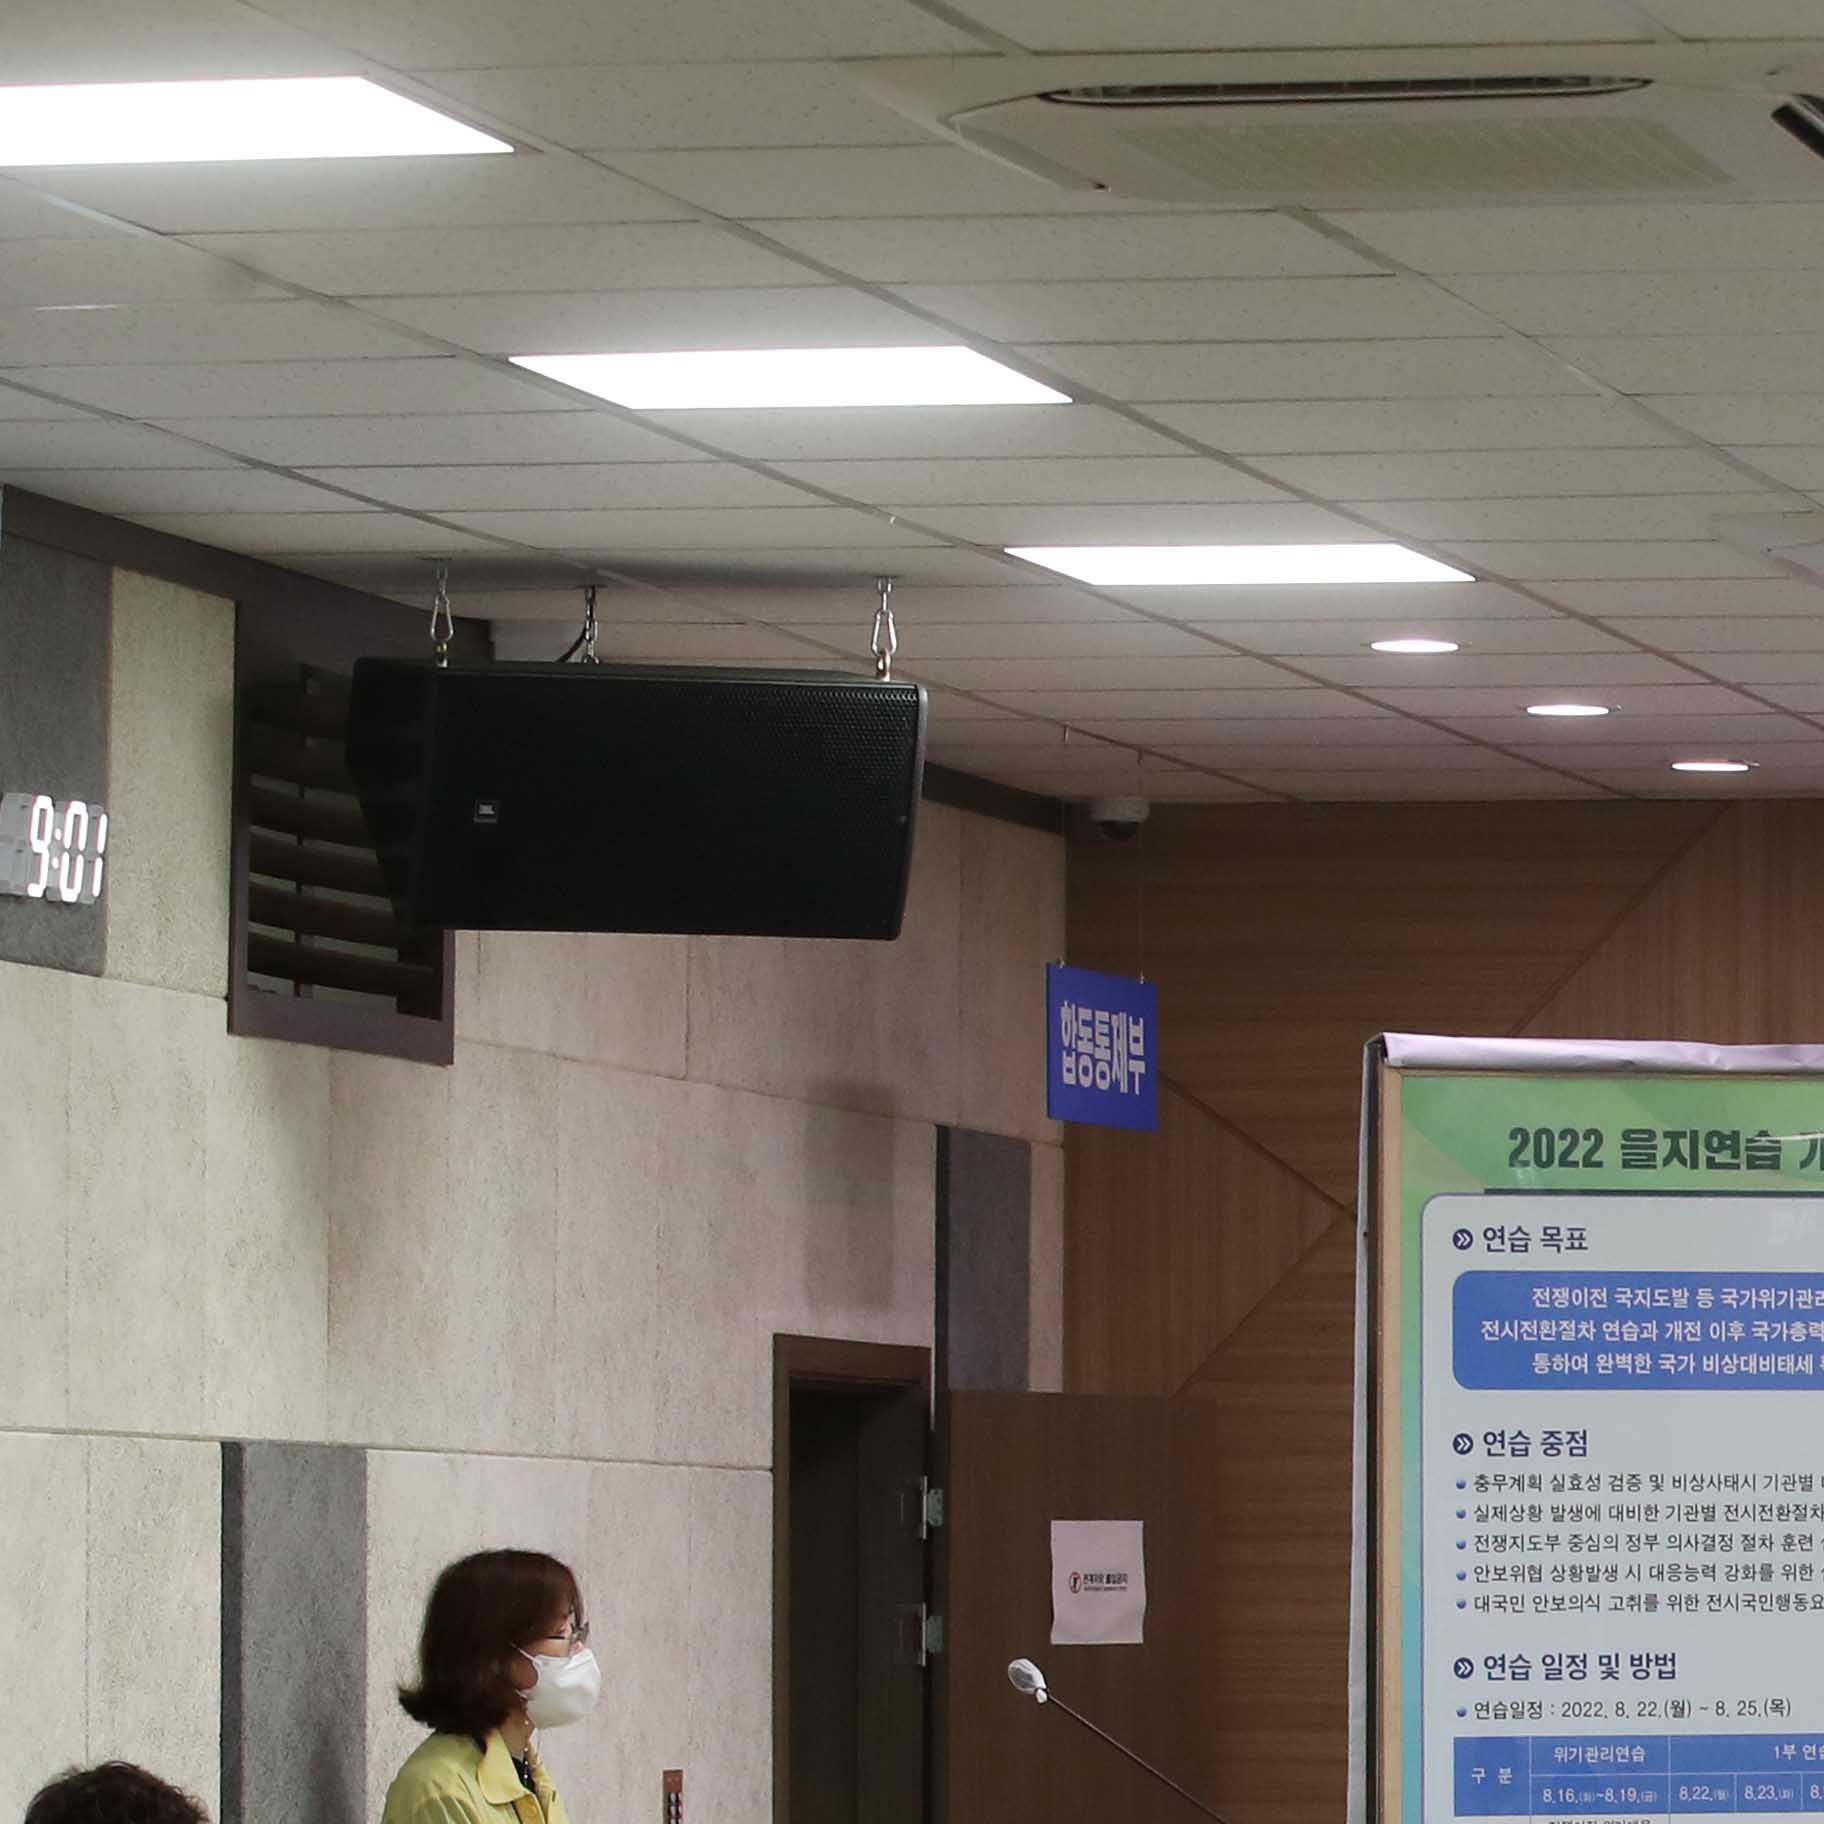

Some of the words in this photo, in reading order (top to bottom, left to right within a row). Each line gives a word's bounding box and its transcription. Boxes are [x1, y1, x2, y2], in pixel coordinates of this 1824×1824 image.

[27, 795, 108, 902] 9:01
[1060, 1000, 1146, 1096] 합동통제부
[1508, 1127, 1604, 1169] 2022
[1619, 1127, 1783, 1171] 을지연습
[1483, 1225, 1532, 1253] 연습
[1540, 1225, 1588, 1253] 목표
[1531, 1287, 1608, 1311] 전쟁이전
[1614, 1287, 1689, 1311] 국지도발
[1695, 1287, 1715, 1311] 등
[1480, 1320, 1596, 1343] 전시전환절차
[1602, 1320, 1659, 1343] 연습과
[1664, 1320, 1702, 1343] 개전
[1709, 1320, 1746, 1343] 이후
[1531, 1353, 1589, 1376] 통하여
[1595, 1353, 1652, 1376] 완벽한
[1658, 1353, 1696, 1376] 국가
[1702, 1353, 1814, 1376] 비상대비태세
[1483, 1430, 1532, 1457] 연습
[1540, 1430, 1588, 1457] 중점
[1473, 1473, 1543, 1493] 충무계획
[1550, 1473, 1601, 1493] 실효성
[1608, 1473, 1642, 1493] 검증
[1648, 1473, 1665, 1493] 및
[1672, 1473, 1757, 1493] 비상사태시
[1763, 1473, 1814, 1493] 기관별
[1473, 1503, 1543, 1523] 실제상황
[1550, 1503, 1601, 1523] 발생에
[1608, 1503, 1659, 1523] 대비한
[1665, 1503, 1717, 1523] 기관별
[1473, 1534, 1561, 1553] 전쟁지도부
[1568, 1534, 1619, 1553] 중심의
[1625, 1534, 1661, 1553] 정부
[1666, 1534, 1734, 1553] 의사결정
[1740, 1534, 1774, 1553] 절차
[1780, 1534, 1814, 1553] 훈련
[1473, 1563, 1543, 1583] 안보위협
[1550, 1563, 1619, 1583] 상황발생
[1625, 1563, 1642, 1583] 시
[1648, 1563, 1717, 1583] 대응능력
[1724, 1563, 1774, 1583] 강화를
[1781, 1563, 1814, 1583] 위한
[1473, 1593, 1526, 1613] 대국민
[1532, 1593, 1601, 1613] 안보의식
[1607, 1593, 1660, 1613] 고취를
[1666, 1593, 1700, 1613] 위한
[1483, 1652, 1532, 1680] 연습
[1540, 1652, 1588, 1680] 일정
[1597, 1652, 1621, 1680] 및
[1629, 1652, 1678, 1680] 방법
[1474, 1701, 1543, 1720] 연습일정
[1561, 1702, 1609, 1719] 2022.
[1553, 1746, 1647, 1764] 위기관리연습
